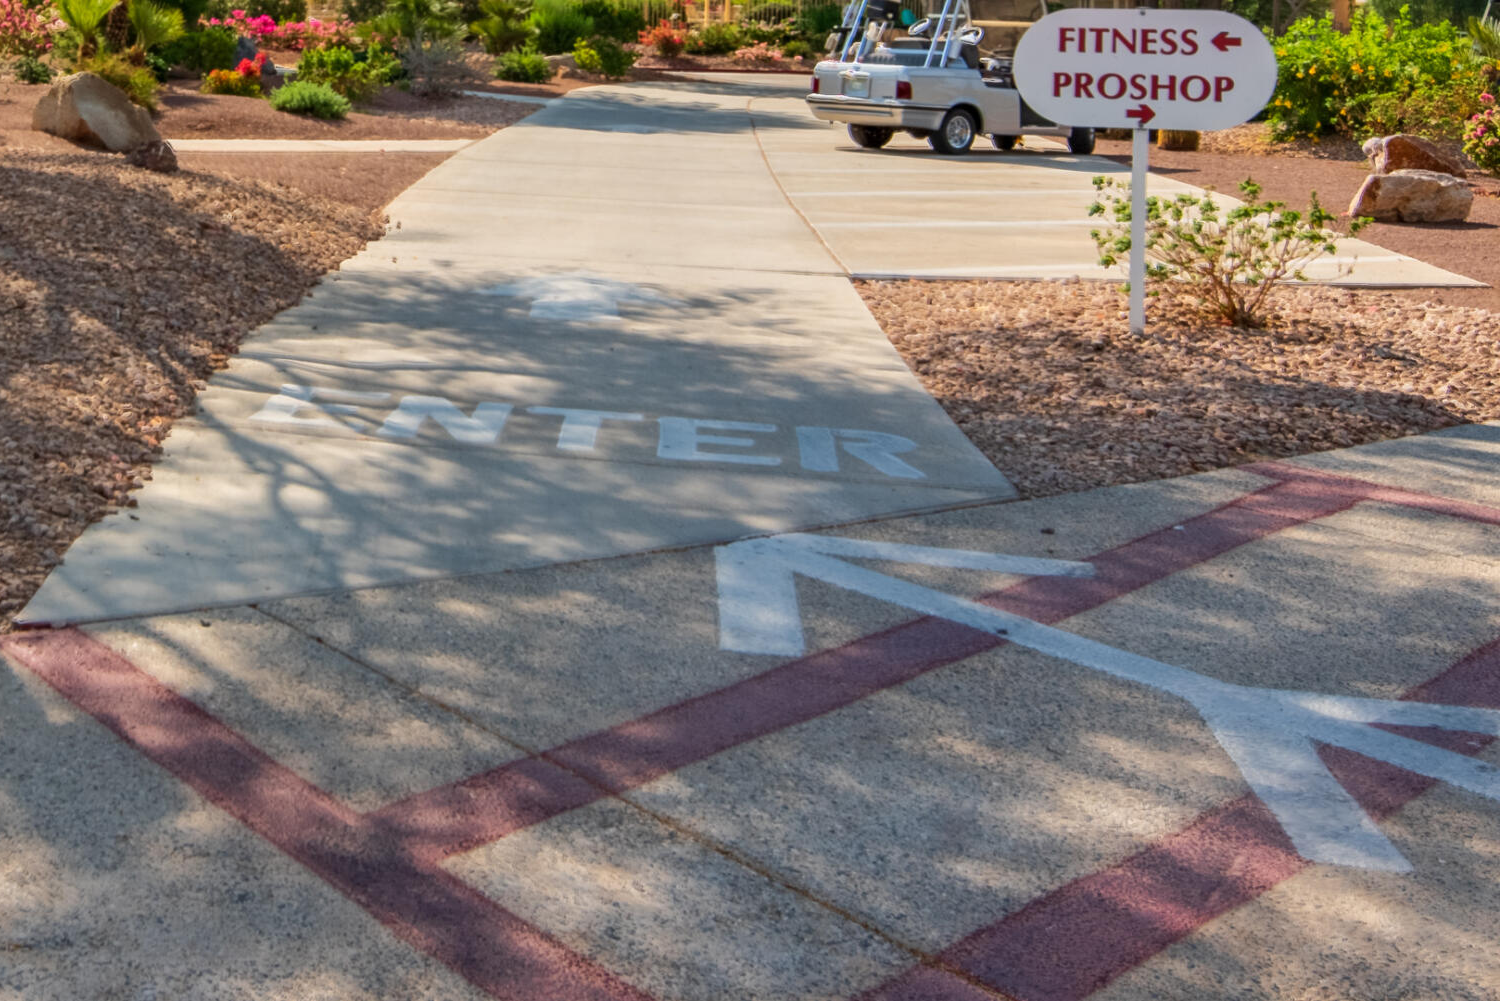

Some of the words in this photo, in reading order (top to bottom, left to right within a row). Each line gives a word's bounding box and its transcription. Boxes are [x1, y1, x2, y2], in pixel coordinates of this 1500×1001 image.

[1058, 27, 1199, 55] FITNESS
[1053, 72, 1235, 103] PROSHOP
[248, 383, 927, 479] ENTER
